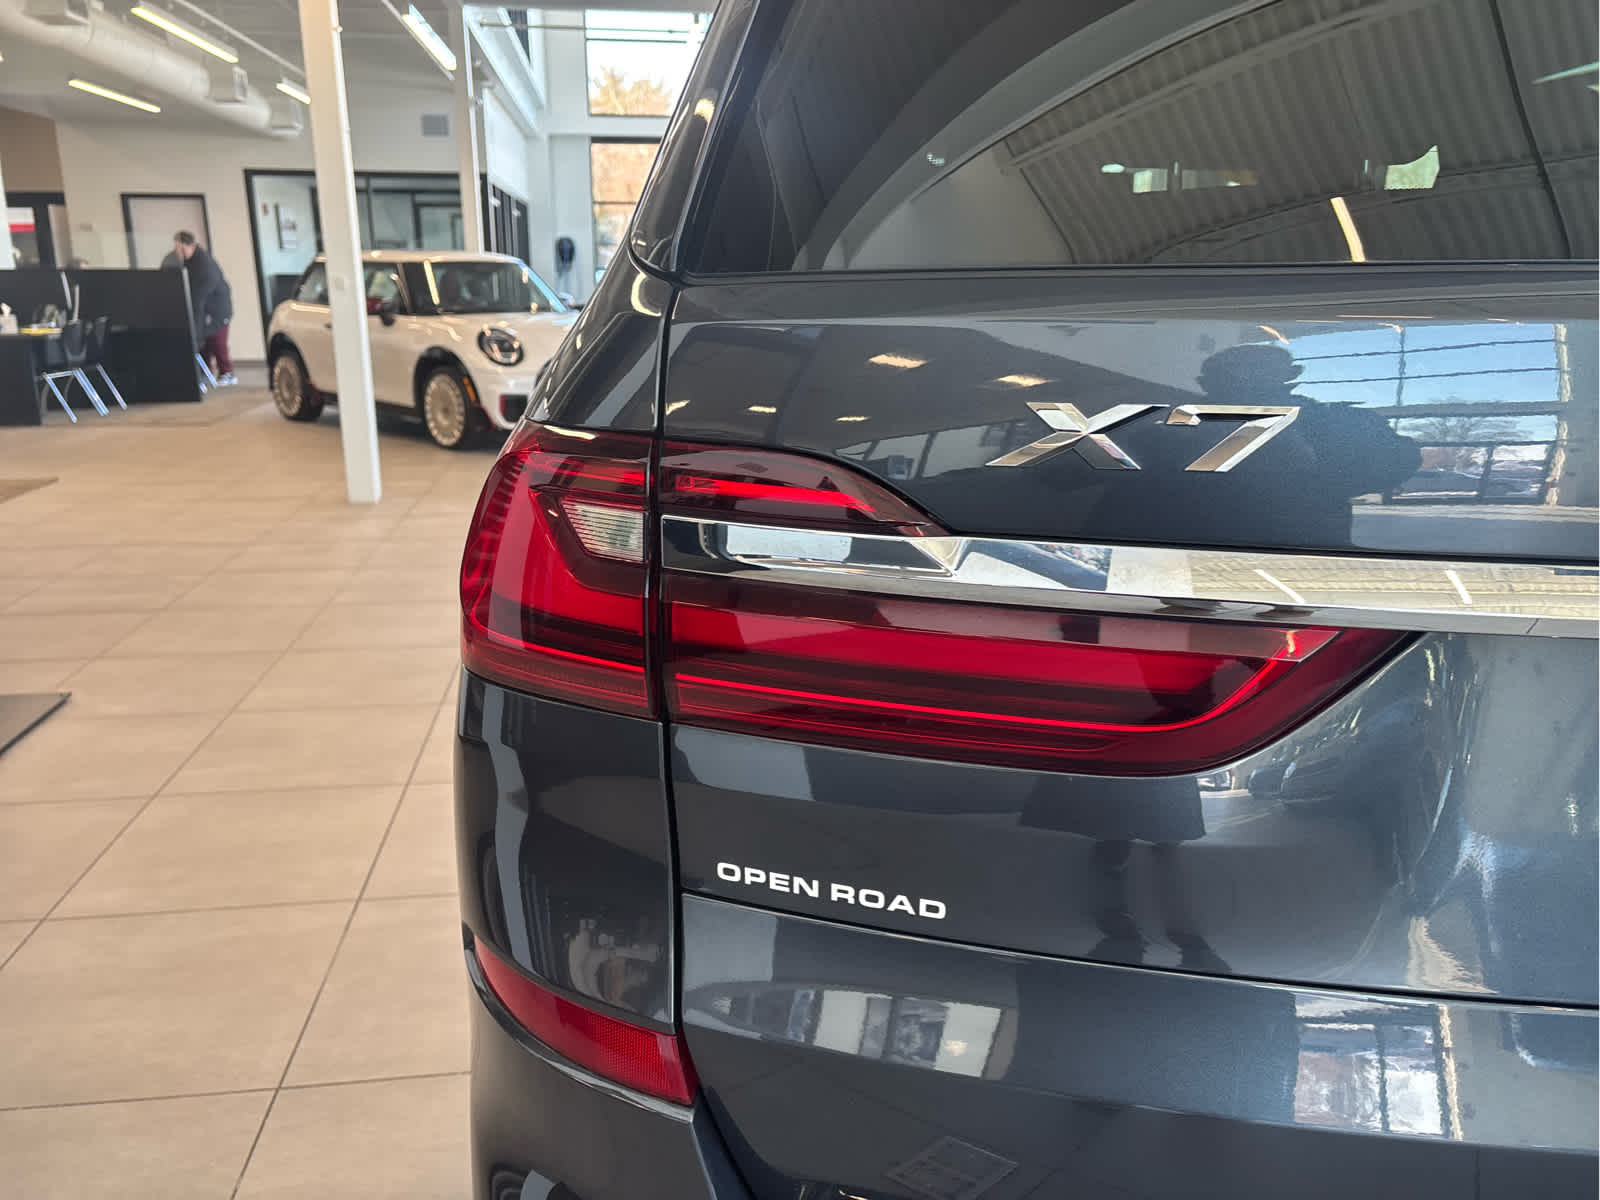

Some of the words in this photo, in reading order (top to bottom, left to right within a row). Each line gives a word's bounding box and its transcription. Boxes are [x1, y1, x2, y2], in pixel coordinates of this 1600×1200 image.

[985, 401, 1300, 473] X7
[716, 862, 820, 898] OPEN
[830, 882, 947, 920] ROAD
